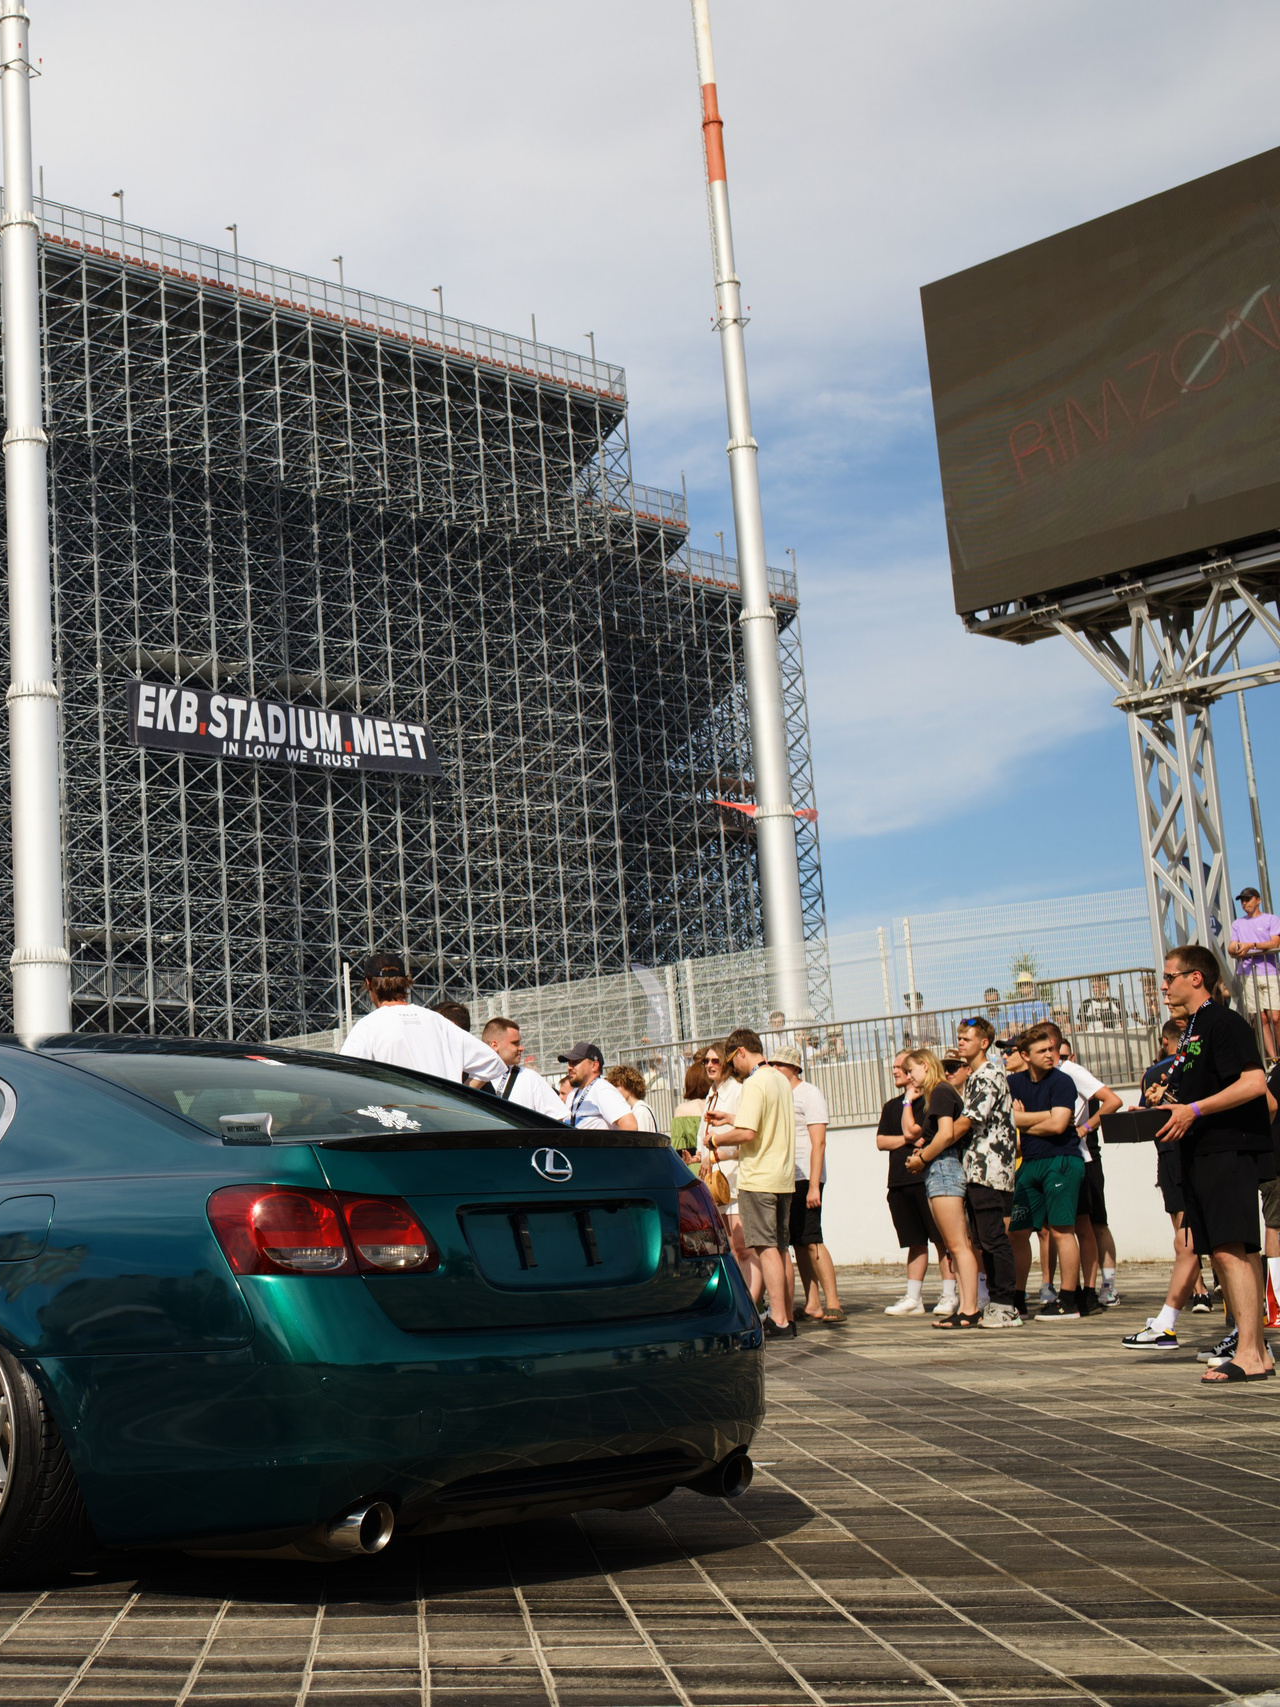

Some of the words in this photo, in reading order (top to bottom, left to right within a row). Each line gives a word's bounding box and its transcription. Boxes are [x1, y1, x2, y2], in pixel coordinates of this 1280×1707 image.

[1009, 293, 1280, 486] RIMZON
[222, 740, 239, 756] IN
[245, 743, 280, 760] LOW
[286, 748, 308, 763] WE
[313, 751, 360, 768] TRUST
